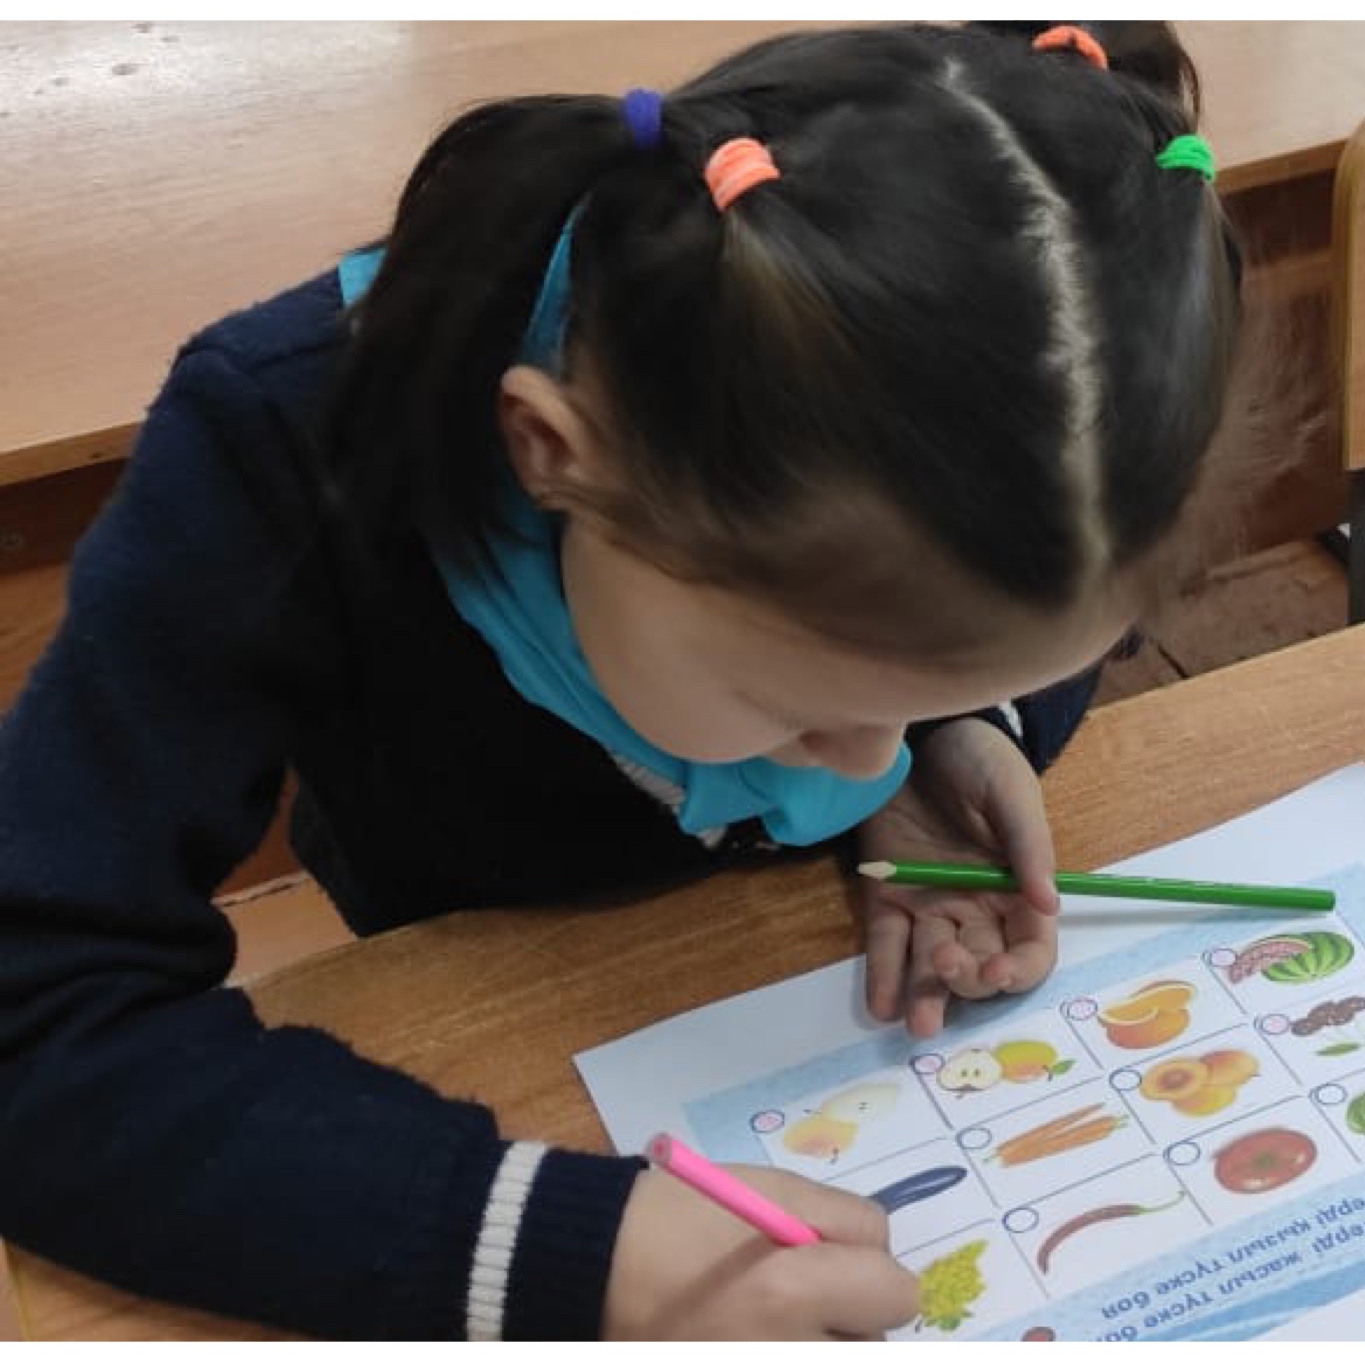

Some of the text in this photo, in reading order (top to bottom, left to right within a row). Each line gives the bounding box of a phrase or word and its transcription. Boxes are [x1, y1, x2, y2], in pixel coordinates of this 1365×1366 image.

[1226, 1218, 1312, 1264] қызыл
[1155, 1257, 1225, 1296] түске
[1218, 1249, 1304, 1297] жасыл
[1100, 1290, 1151, 1320] боя
[1143, 1290, 1215, 1329] түске
